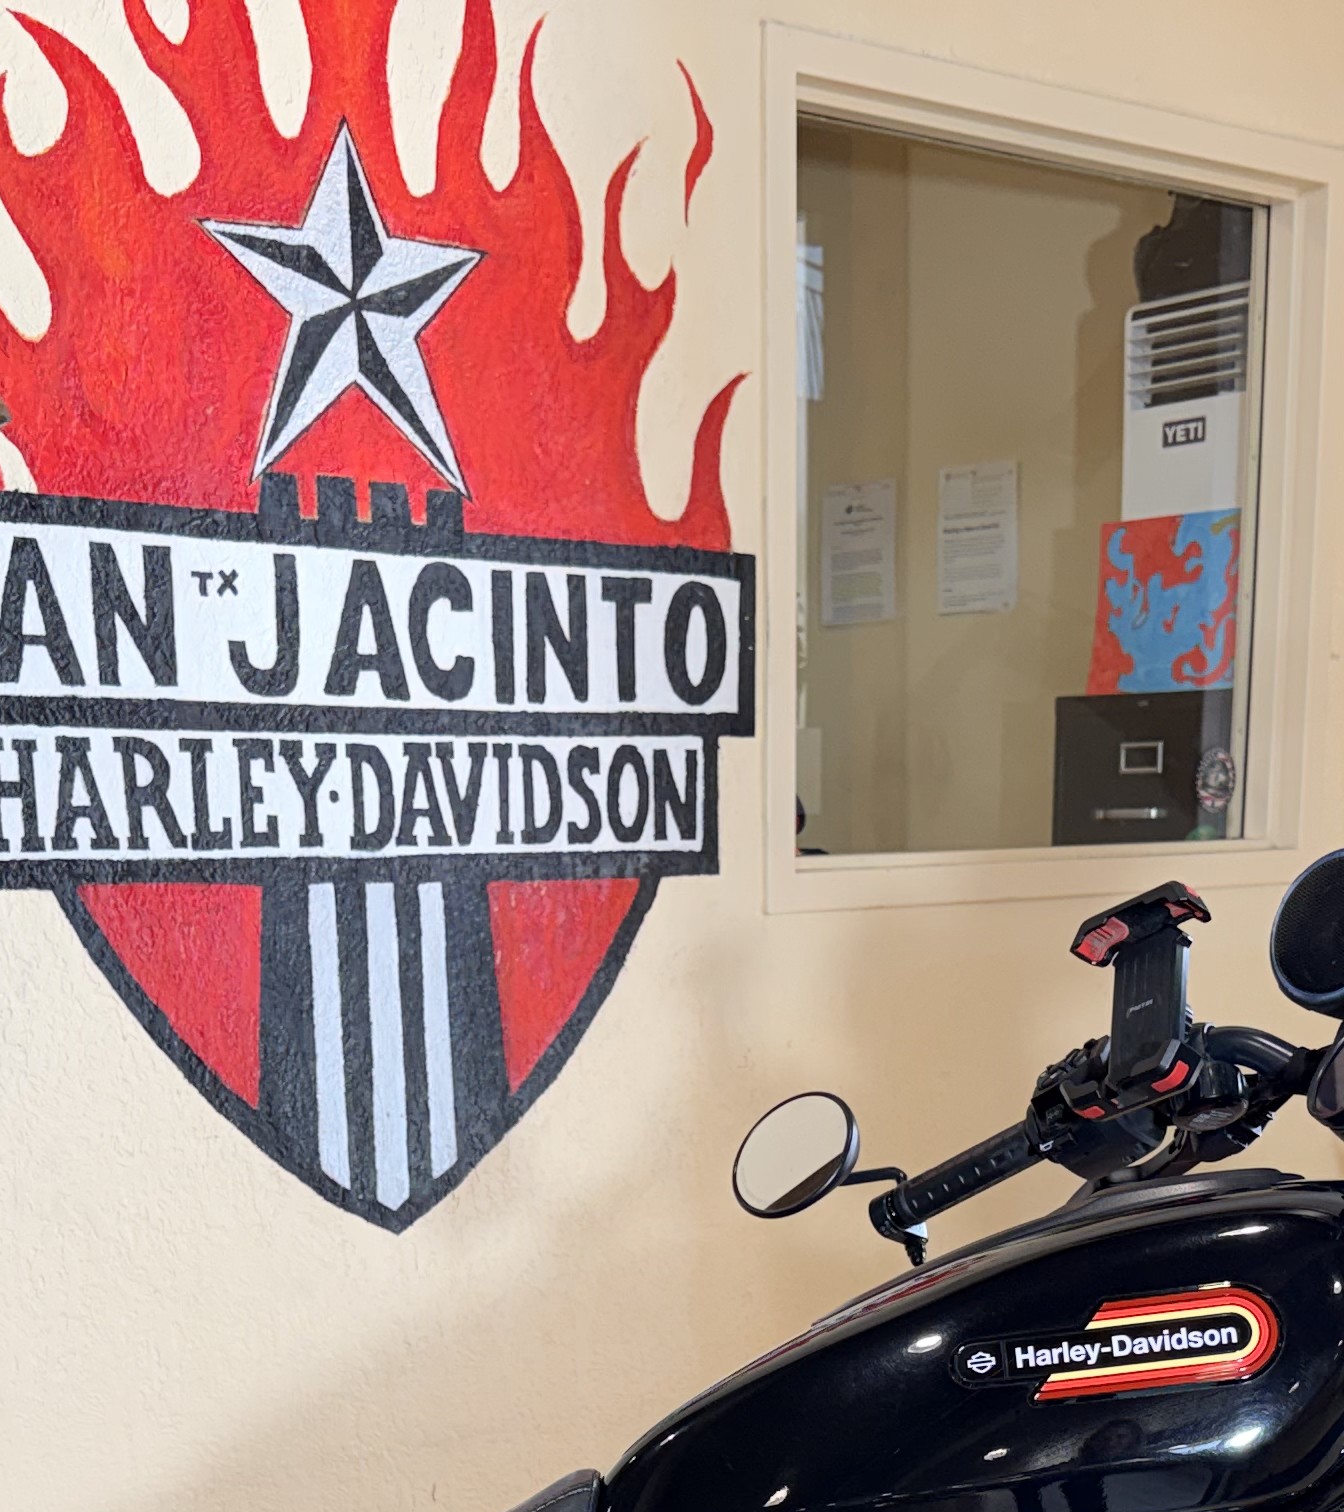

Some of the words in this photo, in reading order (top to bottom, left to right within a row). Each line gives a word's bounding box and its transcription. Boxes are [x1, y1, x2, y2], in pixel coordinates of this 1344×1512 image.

[1164, 419, 1204, 444] YETI
[192, 568, 239, 598] TX
[228, 553, 727, 706] JACINTO
[1014, 1326, 1238, 1369] Harley-Davidson
